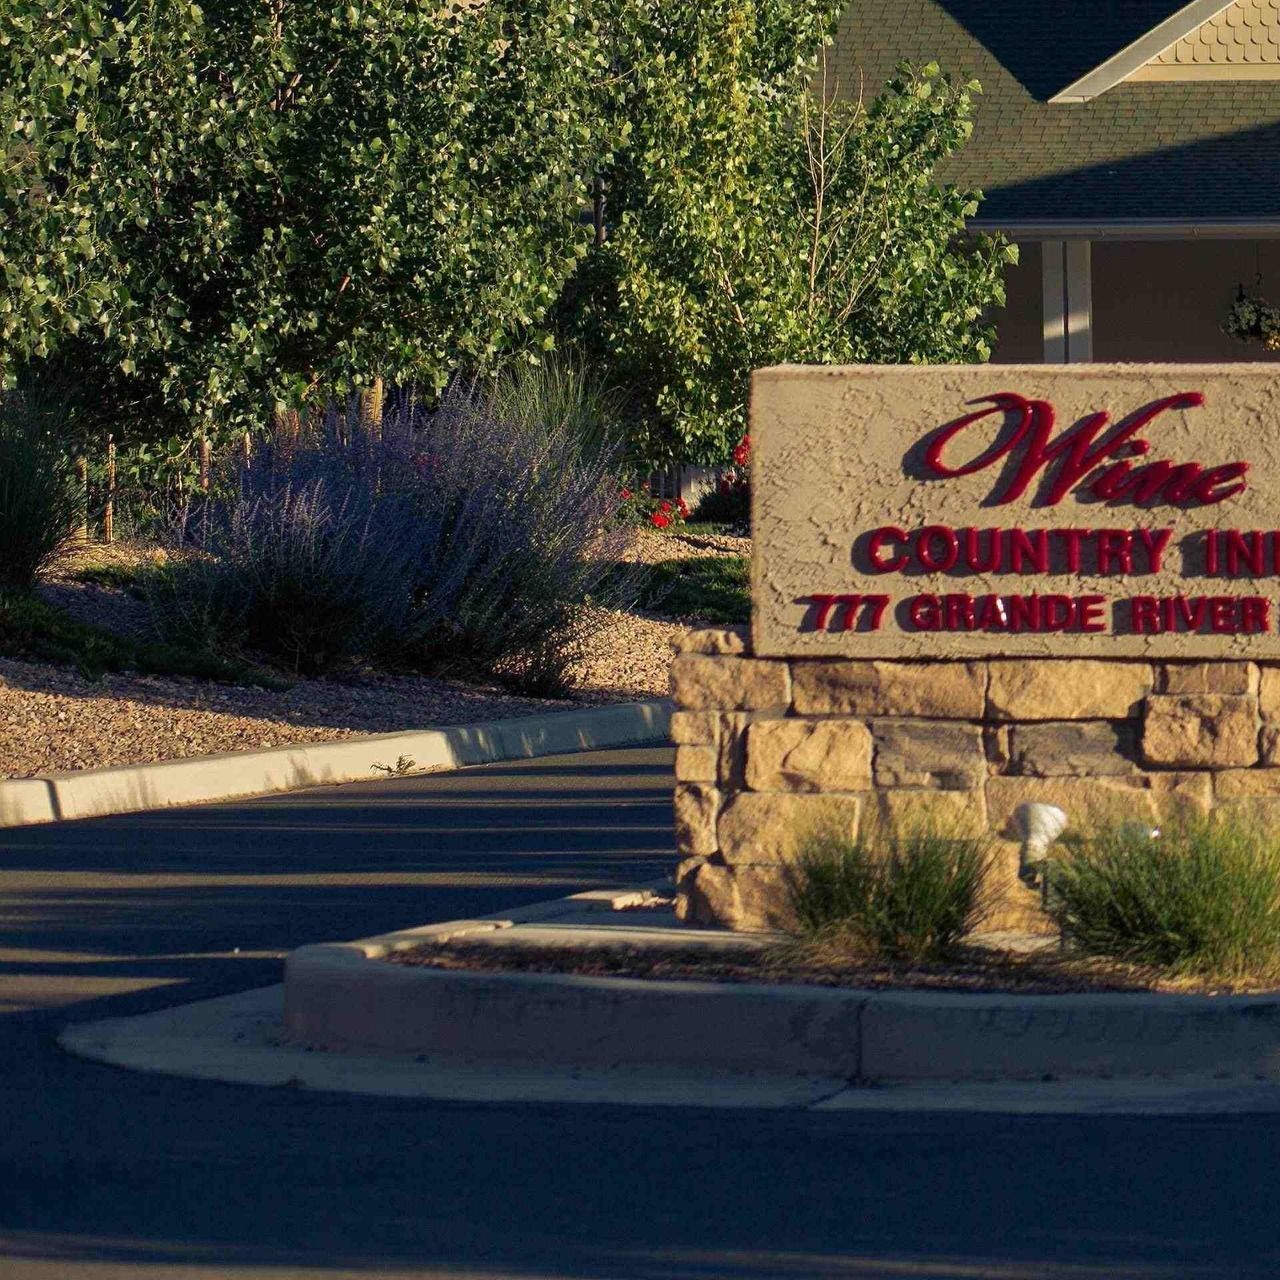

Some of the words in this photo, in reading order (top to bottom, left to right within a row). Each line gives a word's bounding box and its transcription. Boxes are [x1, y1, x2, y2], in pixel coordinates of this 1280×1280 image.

[924, 391, 1252, 508] Wine
[867, 524, 1175, 576] COUNTRY
[802, 592, 891, 633] 777
[911, 591, 1108, 634] GRANDE
[1131, 593, 1271, 635] RIVER
